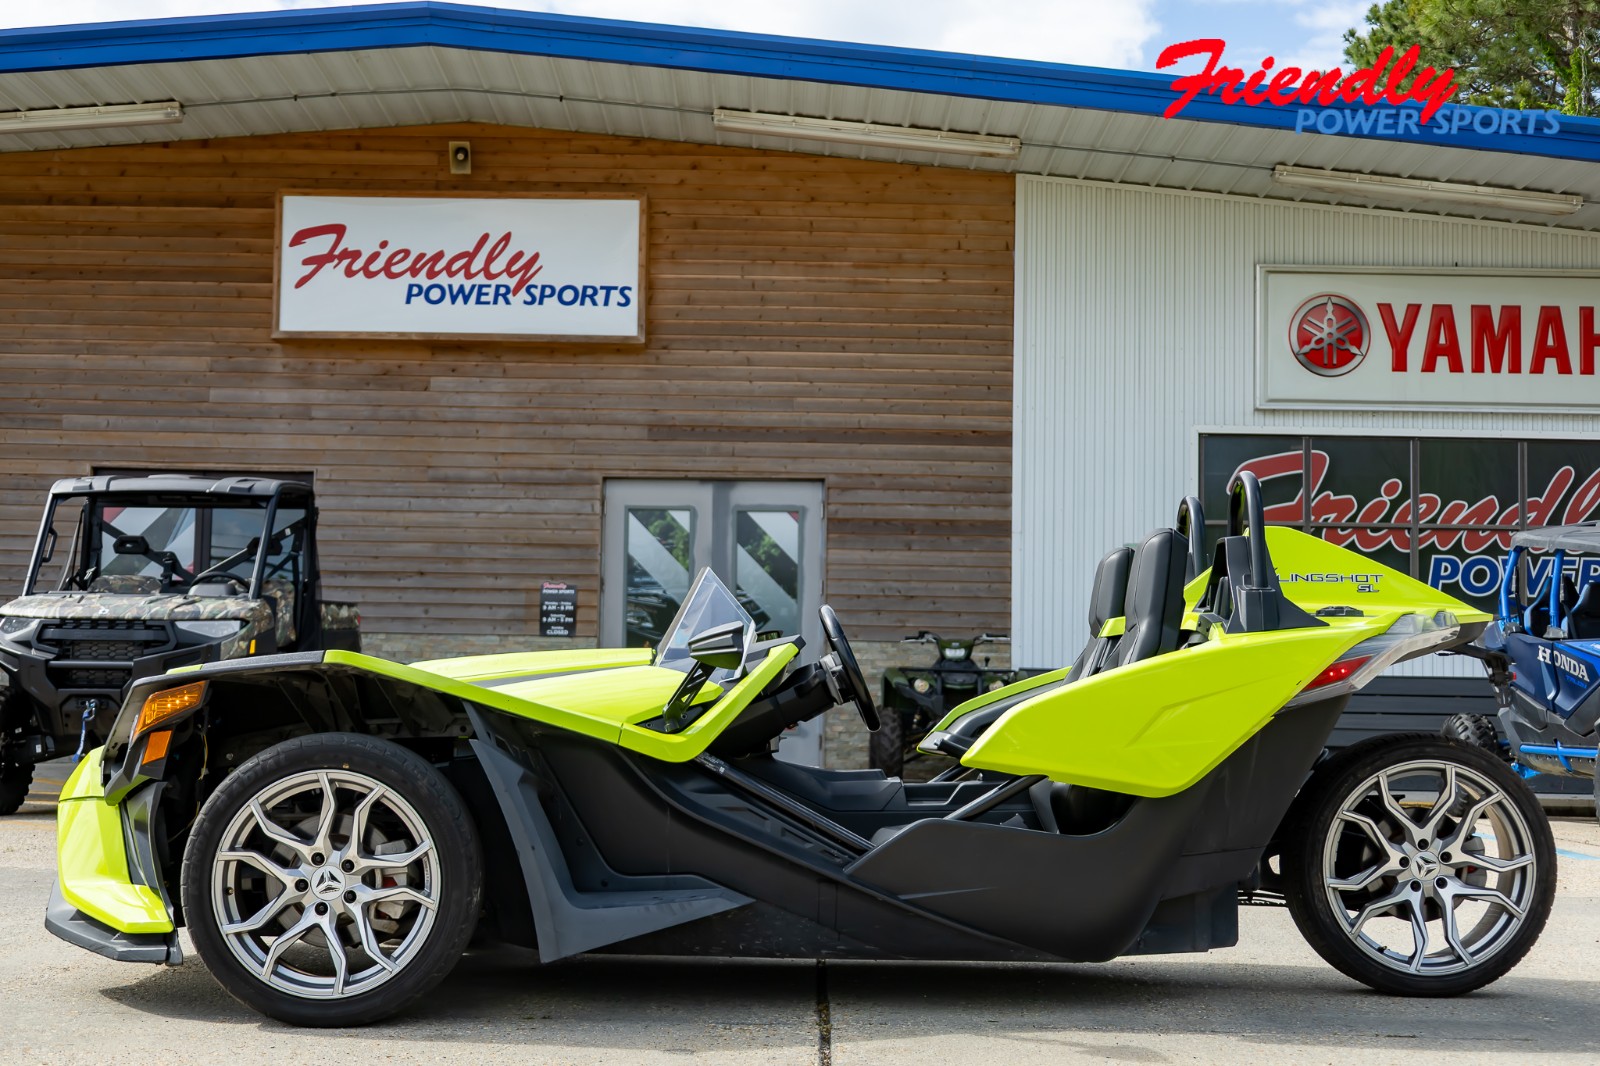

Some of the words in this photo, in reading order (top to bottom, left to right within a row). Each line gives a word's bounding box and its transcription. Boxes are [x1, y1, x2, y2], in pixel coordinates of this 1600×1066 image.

[288, 223, 543, 297] Friendly
[405, 283, 512, 306] POWER
[523, 284, 632, 308] SPORTS
[1357, 584, 1379, 593] SL
[1537, 645, 1590, 682] HONDA
